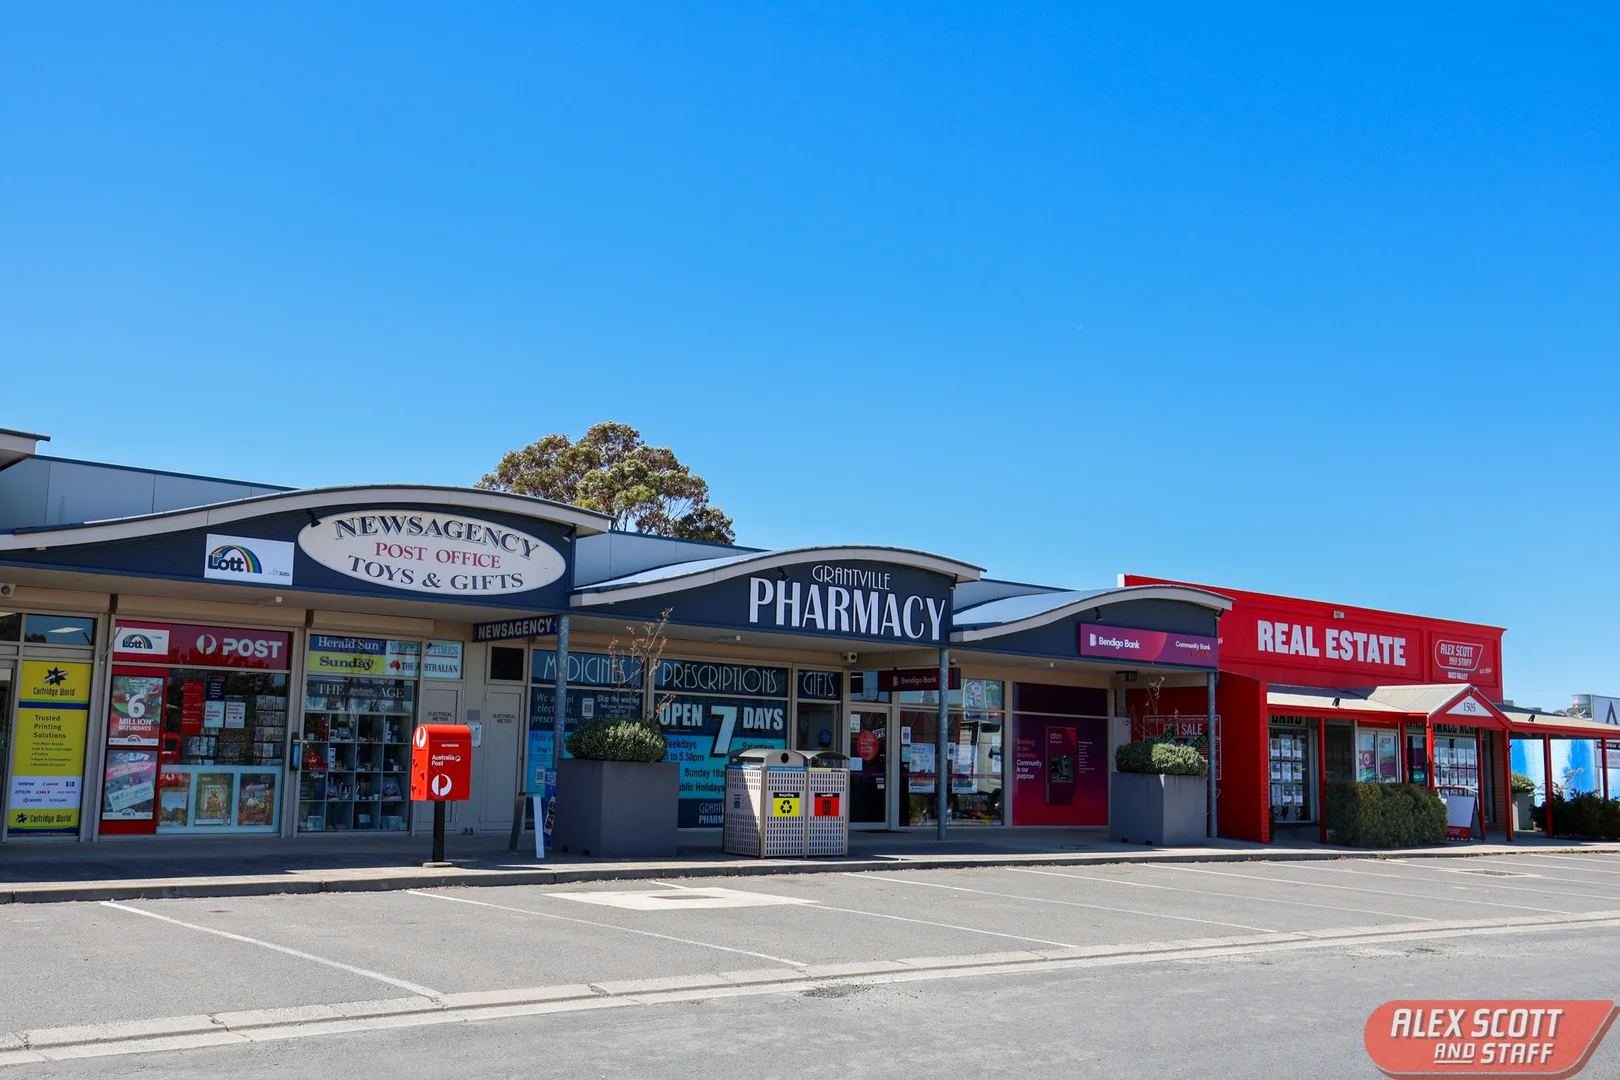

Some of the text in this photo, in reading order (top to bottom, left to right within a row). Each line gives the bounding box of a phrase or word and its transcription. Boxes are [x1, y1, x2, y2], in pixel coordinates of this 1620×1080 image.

[334, 515, 540, 560] NEWSAGENCY
[375, 542, 501, 569] POST OFFICE
[348, 555, 524, 590] TOYS & GIFTS
[812, 565, 890, 590] GRANTVILLE
[749, 577, 946, 640] PHARMACY
[478, 617, 552, 640] NEWSAGENCY
[222, 638, 283, 658] POST
[318, 637, 379, 650] Herald Sun
[1099, 636, 1140, 649] Bendigo Bank
[1176, 641, 1199, 650] Community
[1258, 620, 1406, 666] REAL ESTATE
[432, 645, 458, 655] TIMES
[1440, 644, 1474, 657] ALEX SCOTT
[319, 657, 374, 670] Sunday
[415, 662, 458, 673] ASTRALIAN
[544, 654, 626, 684] MDICINES
[662, 662, 777, 693] PRESCRIPTIONS
[901, 676, 922, 686] Bendigo
[317, 684, 345, 696] THE
[378, 688, 404, 698] AGE
[803, 672, 834, 697] GIFTS
[33, 687, 76, 696] Cartridge World
[537, 693, 574, 703] We apt
[597, 695, 609, 703] Skip
[1463, 702, 1476, 713] 1505
[531, 716, 578, 726] prescrons
[660, 703, 784, 755] OPEN 7 DAYS
[1182, 724, 1202, 735] SALE
[1433, 723, 1457, 733] SMALL
[668, 740, 697, 751] eekdays
[1192, 735, 1207, 750] OLD
[679, 752, 704, 763] 5.30pm
[1017, 760, 1042, 768] Community
[684, 769, 710, 778] Sunday
[696, 783, 725, 794] Holidays
[30, 815, 54, 823] Cartridge
